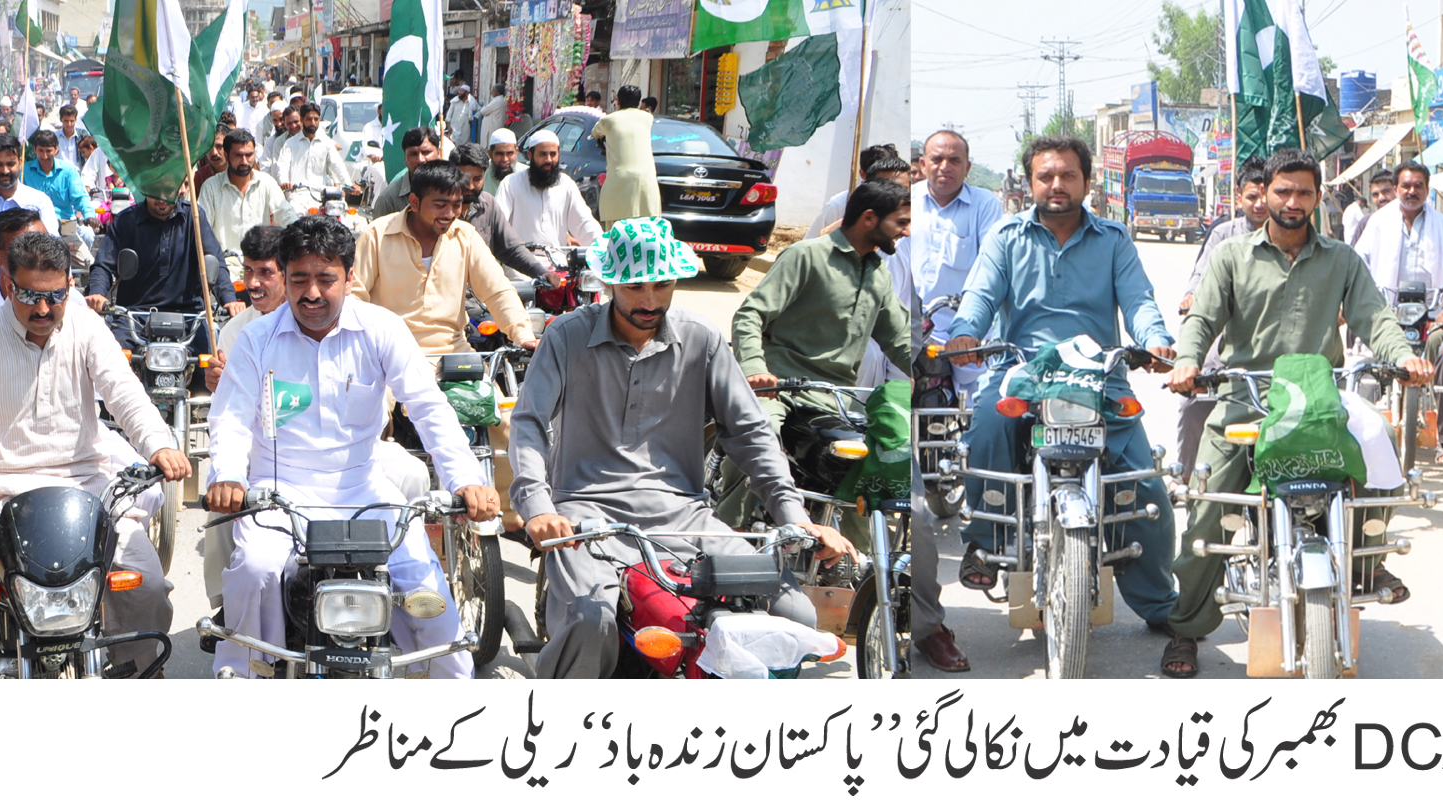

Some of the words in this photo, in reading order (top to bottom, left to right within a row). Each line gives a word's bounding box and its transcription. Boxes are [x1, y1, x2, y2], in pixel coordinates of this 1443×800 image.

[1289, 482, 1327, 490] HONDA
[36, 642, 81, 653] UNIQUE
[326, 655, 371, 664] HONDA
